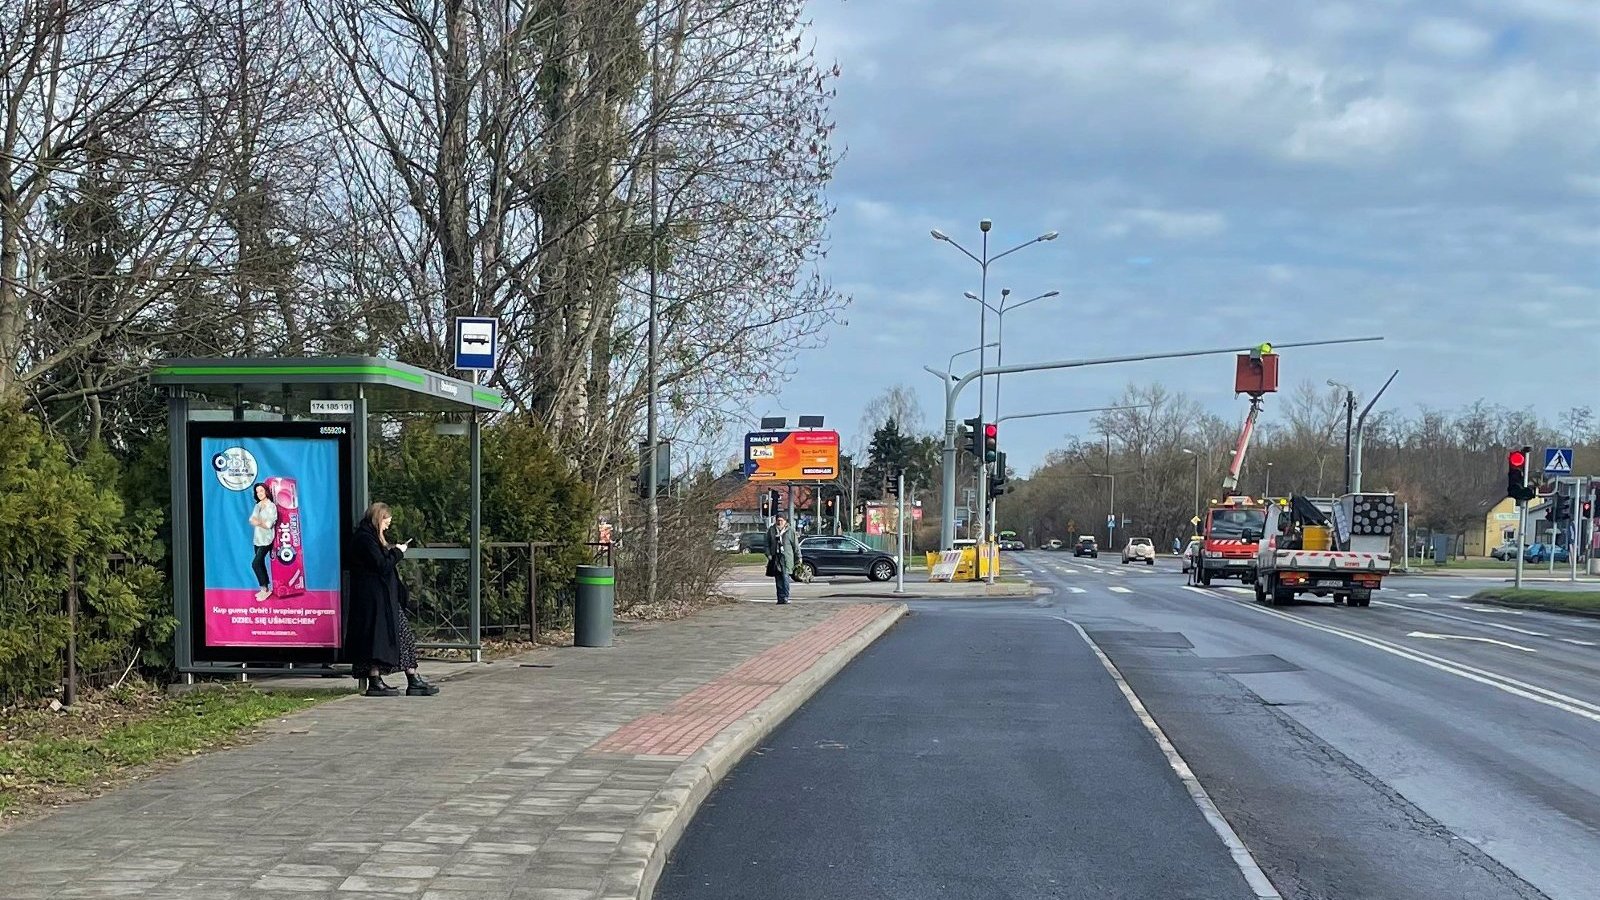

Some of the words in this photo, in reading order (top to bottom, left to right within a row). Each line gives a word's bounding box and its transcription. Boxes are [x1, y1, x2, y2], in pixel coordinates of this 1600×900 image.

[279, 522, 294, 562] Orbit
[212, 606, 227, 615] Kup
[249, 606, 268, 614] Orbit
[305, 609, 336, 617] program
